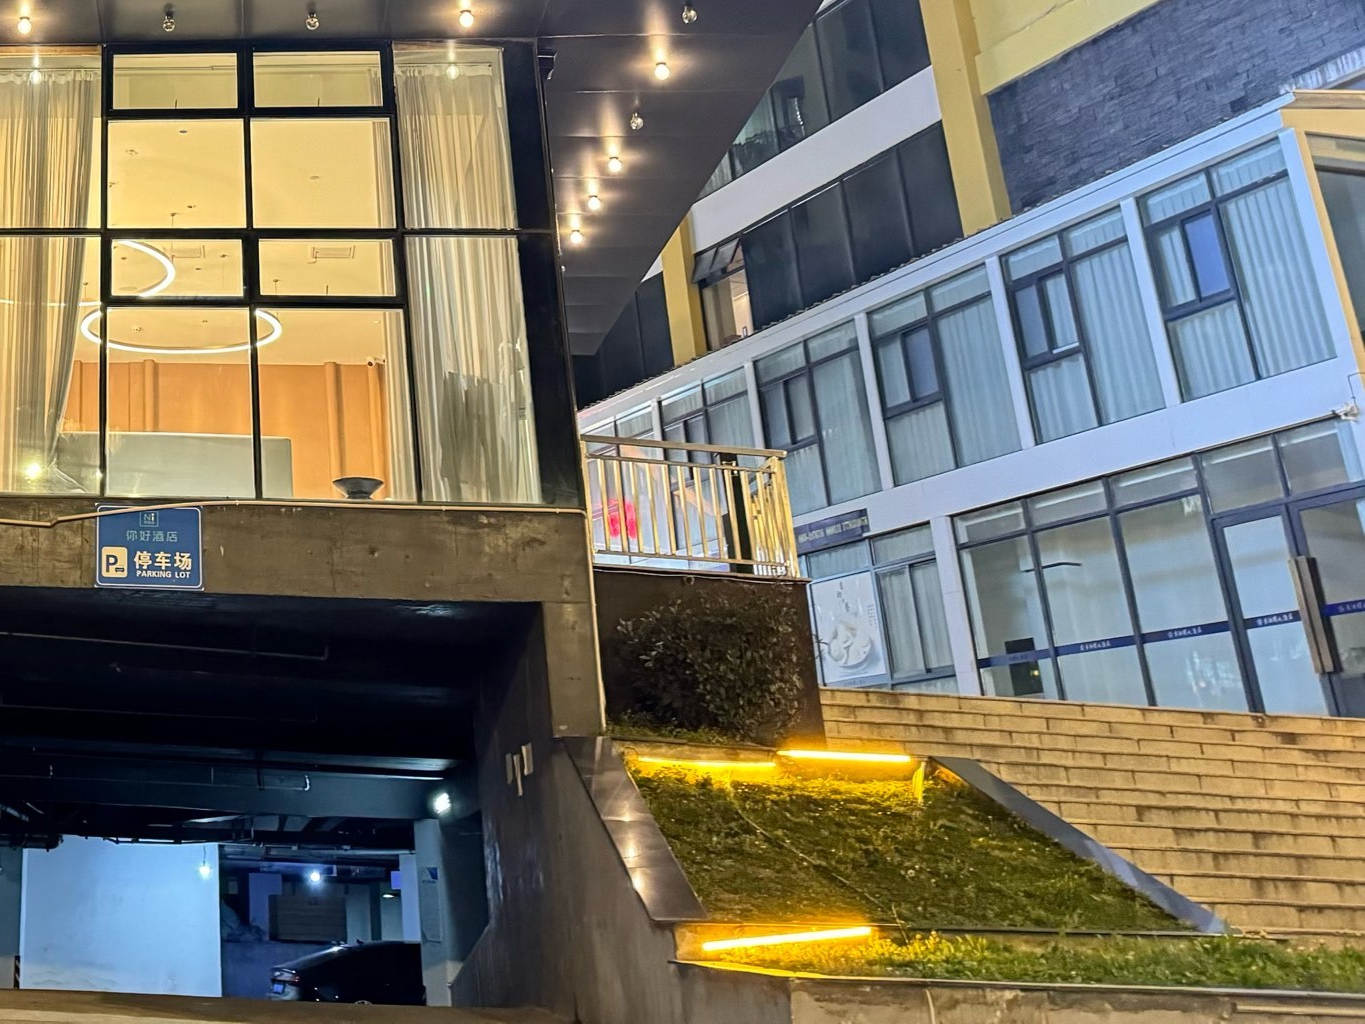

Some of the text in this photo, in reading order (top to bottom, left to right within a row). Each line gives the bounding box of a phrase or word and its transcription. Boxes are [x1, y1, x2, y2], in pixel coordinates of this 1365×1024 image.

[126, 530, 178, 542] 你好酒店
[134, 551, 192, 571] 停车场
[136, 570, 191, 579] PARKING LOT
